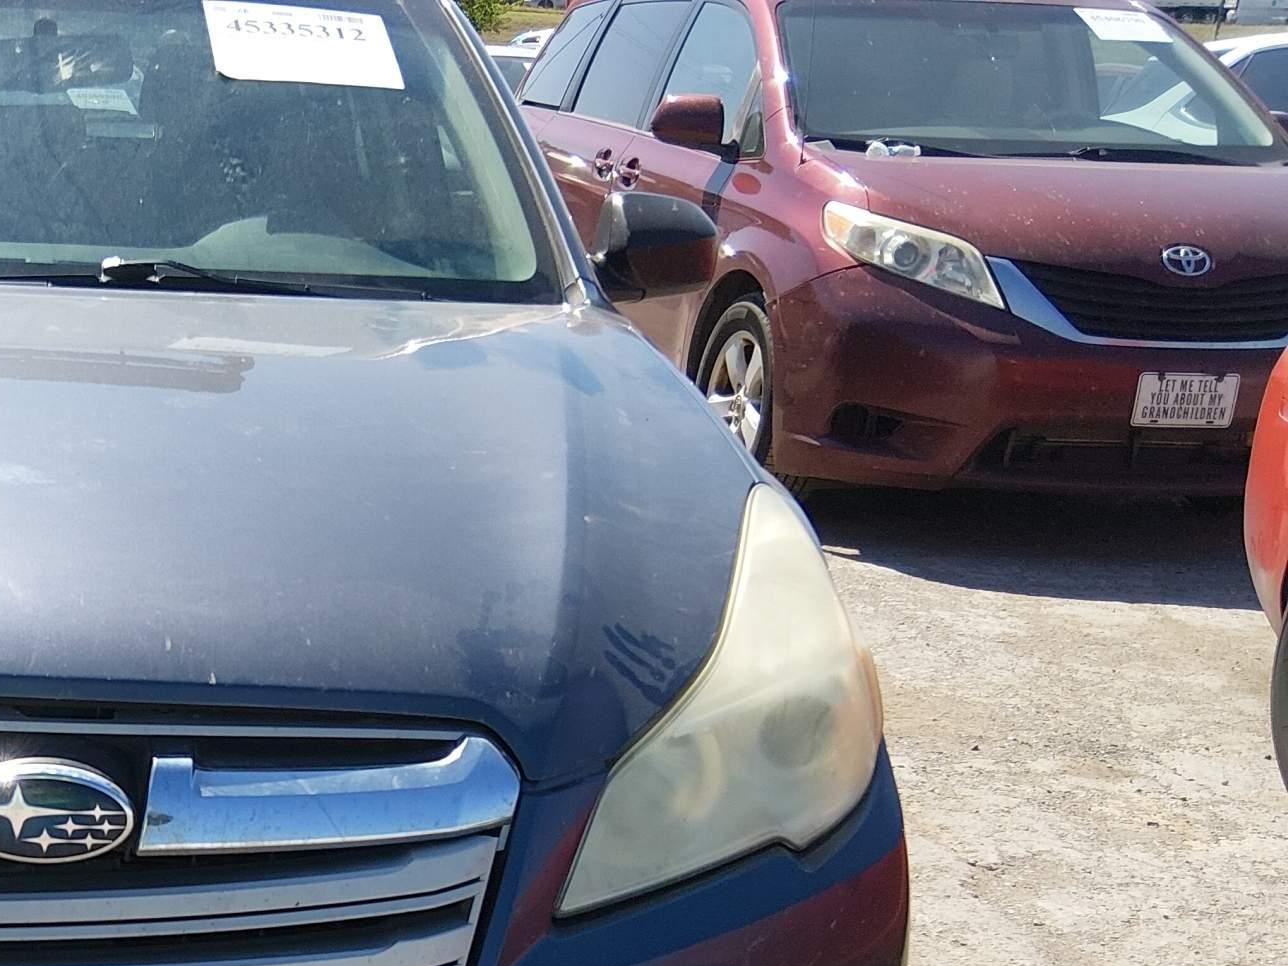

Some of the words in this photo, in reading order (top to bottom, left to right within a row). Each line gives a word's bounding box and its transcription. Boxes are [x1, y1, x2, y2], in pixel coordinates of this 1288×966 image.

[226, 18, 367, 42] 45335312
[1158, 379, 1176, 393] LET
[1179, 379, 1194, 393] ME
[1198, 379, 1219, 393] TELL
[1150, 392, 1170, 406] YOU
[1174, 392, 1205, 406] ABOUT
[1208, 393, 1224, 407] MY
[1141, 406, 1227, 421] GRANDCHILDREN
